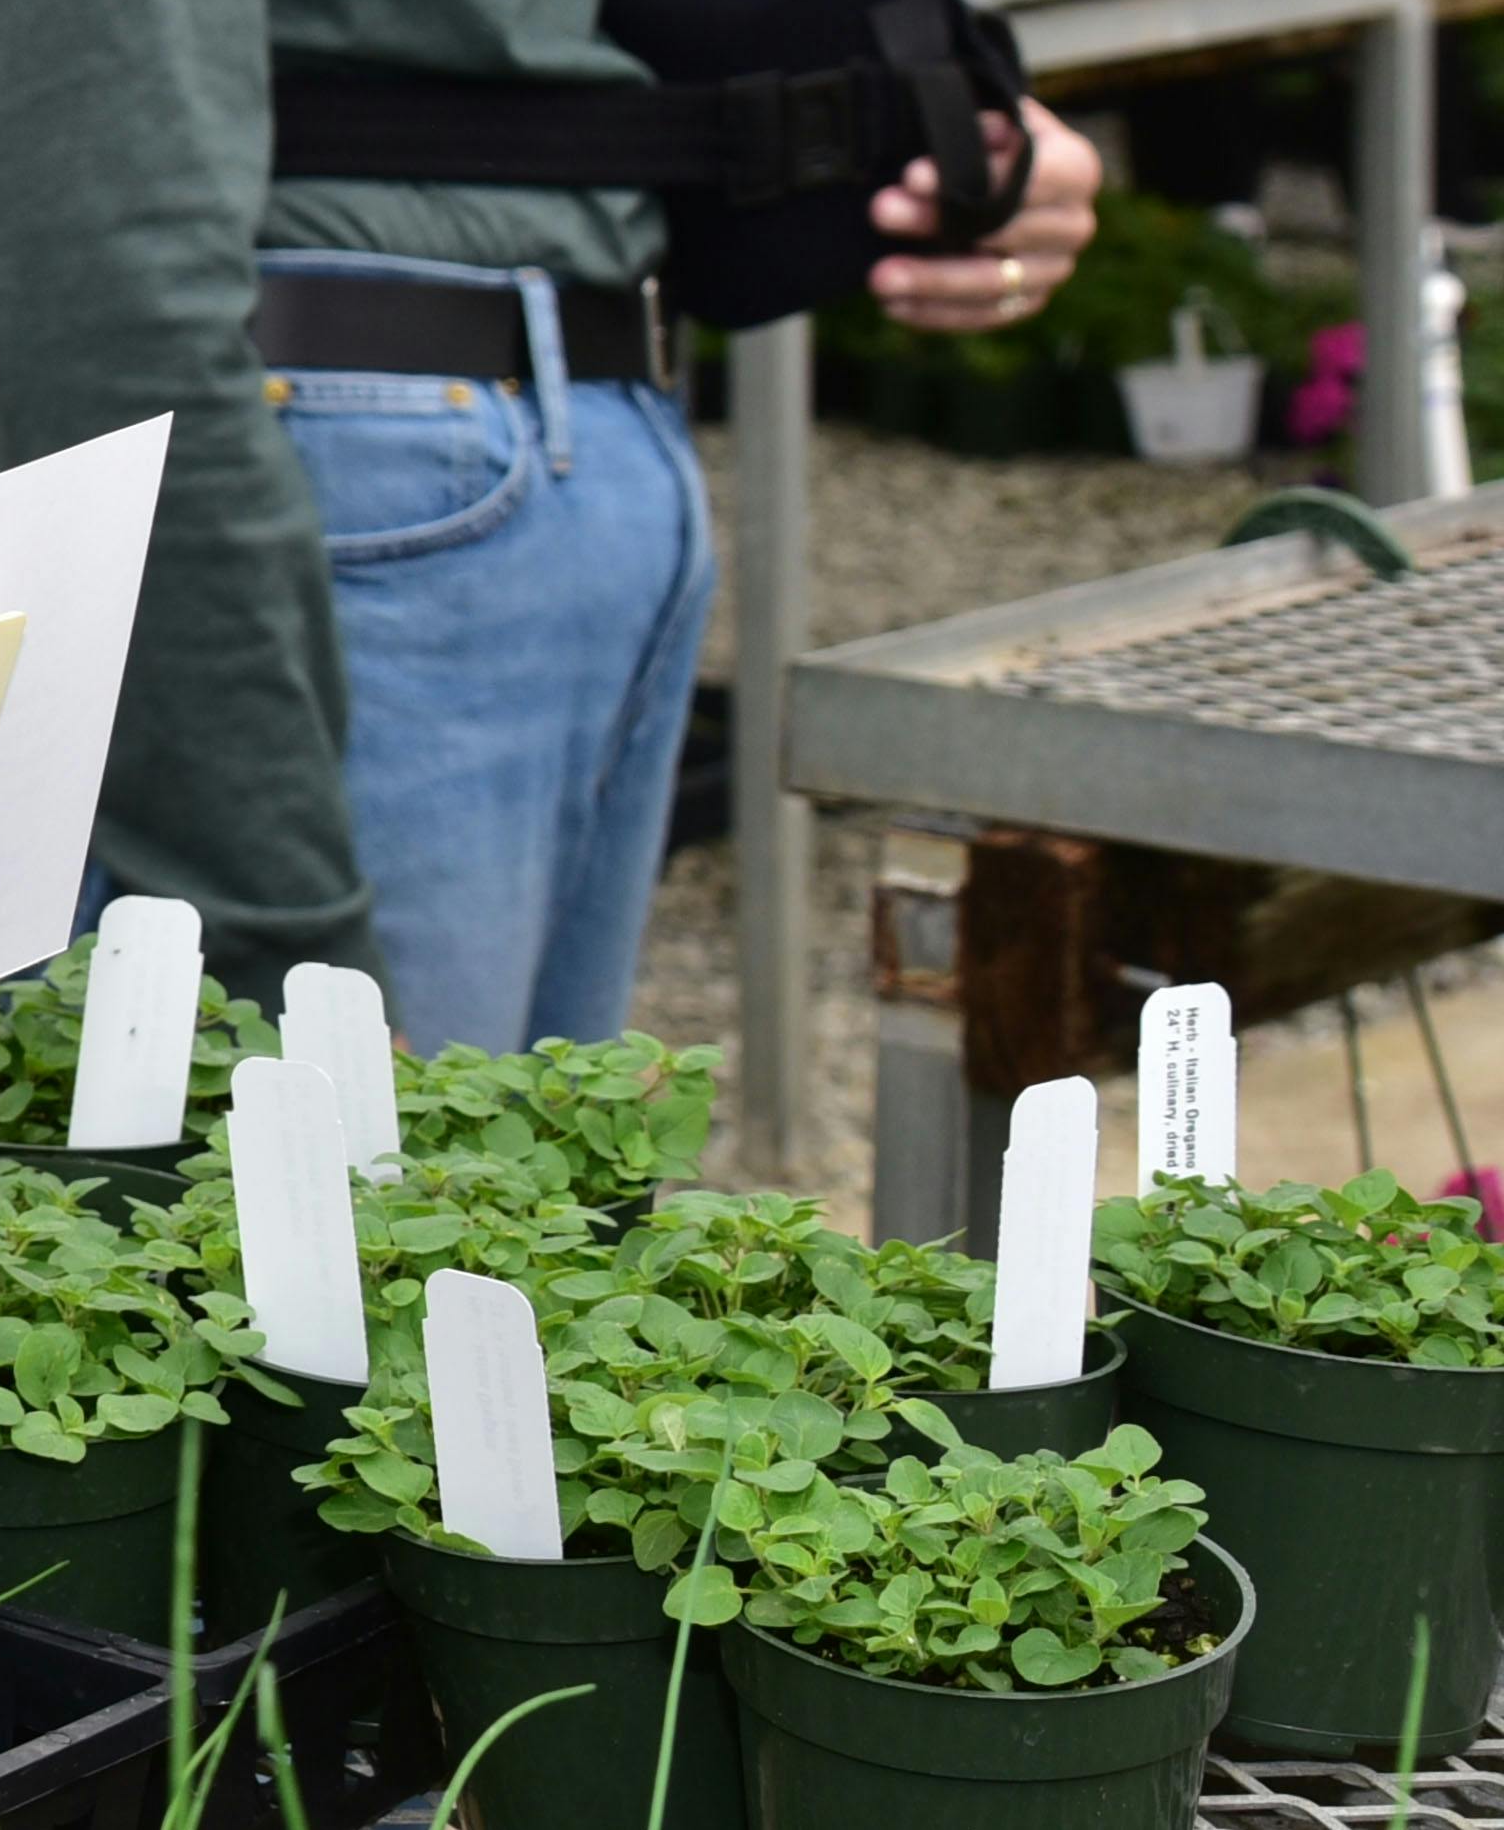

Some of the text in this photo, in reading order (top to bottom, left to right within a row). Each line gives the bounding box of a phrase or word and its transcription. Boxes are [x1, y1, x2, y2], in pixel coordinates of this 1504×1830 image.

[1185, 1006, 1200, 1042] Herb
[1185, 1057, 1200, 1104] Italian
[1165, 1131, 1180, 1168] dried
[1183, 1108, 1200, 1169] Oregano
